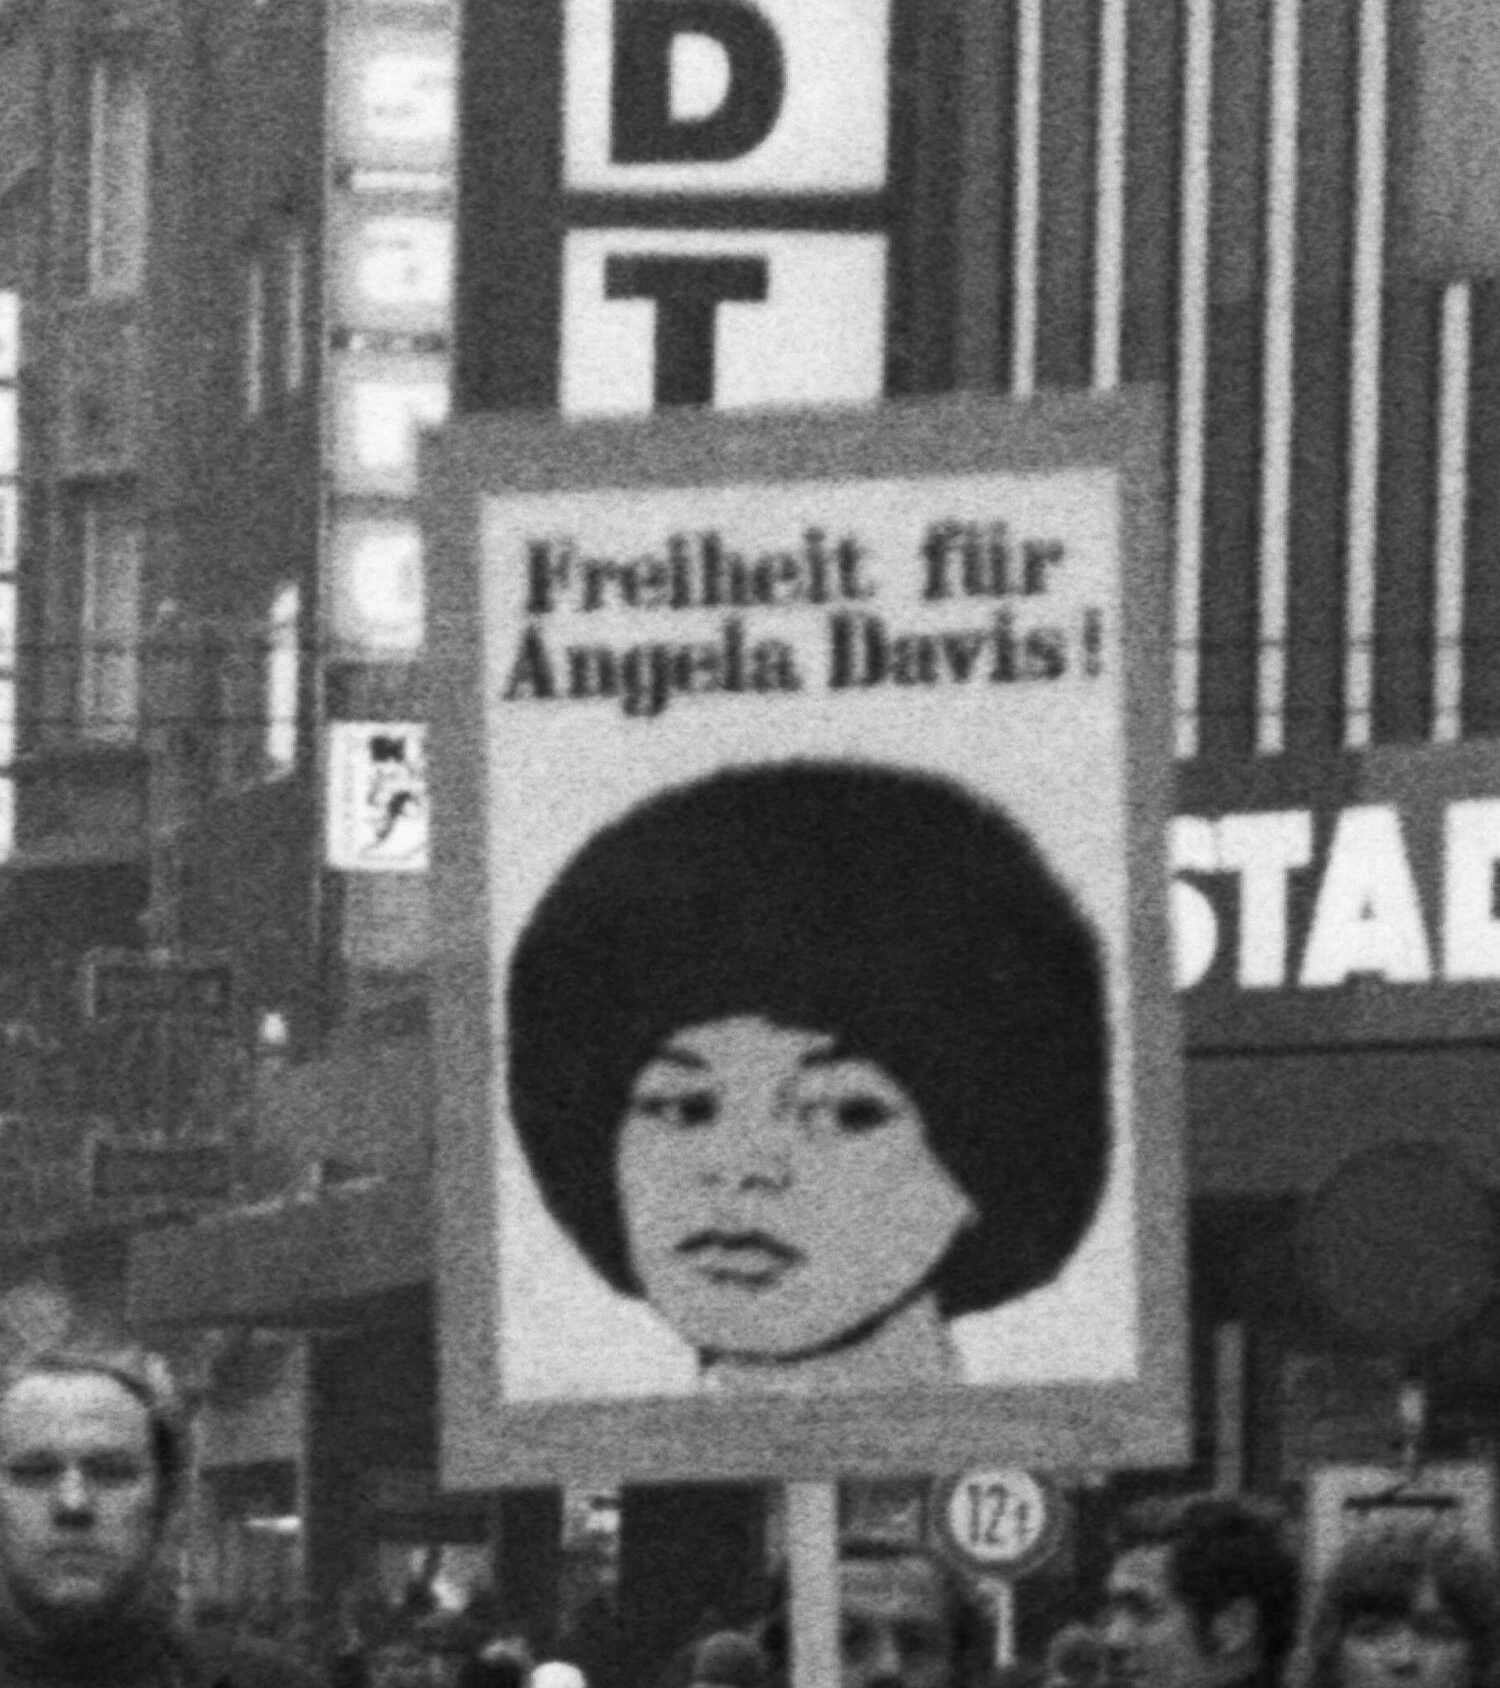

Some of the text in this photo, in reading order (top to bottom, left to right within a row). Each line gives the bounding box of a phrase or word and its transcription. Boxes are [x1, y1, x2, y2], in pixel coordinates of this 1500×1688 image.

[525, 522, 1063, 617] Freiheit für
[505, 612, 1100, 718] Angela Davis!
